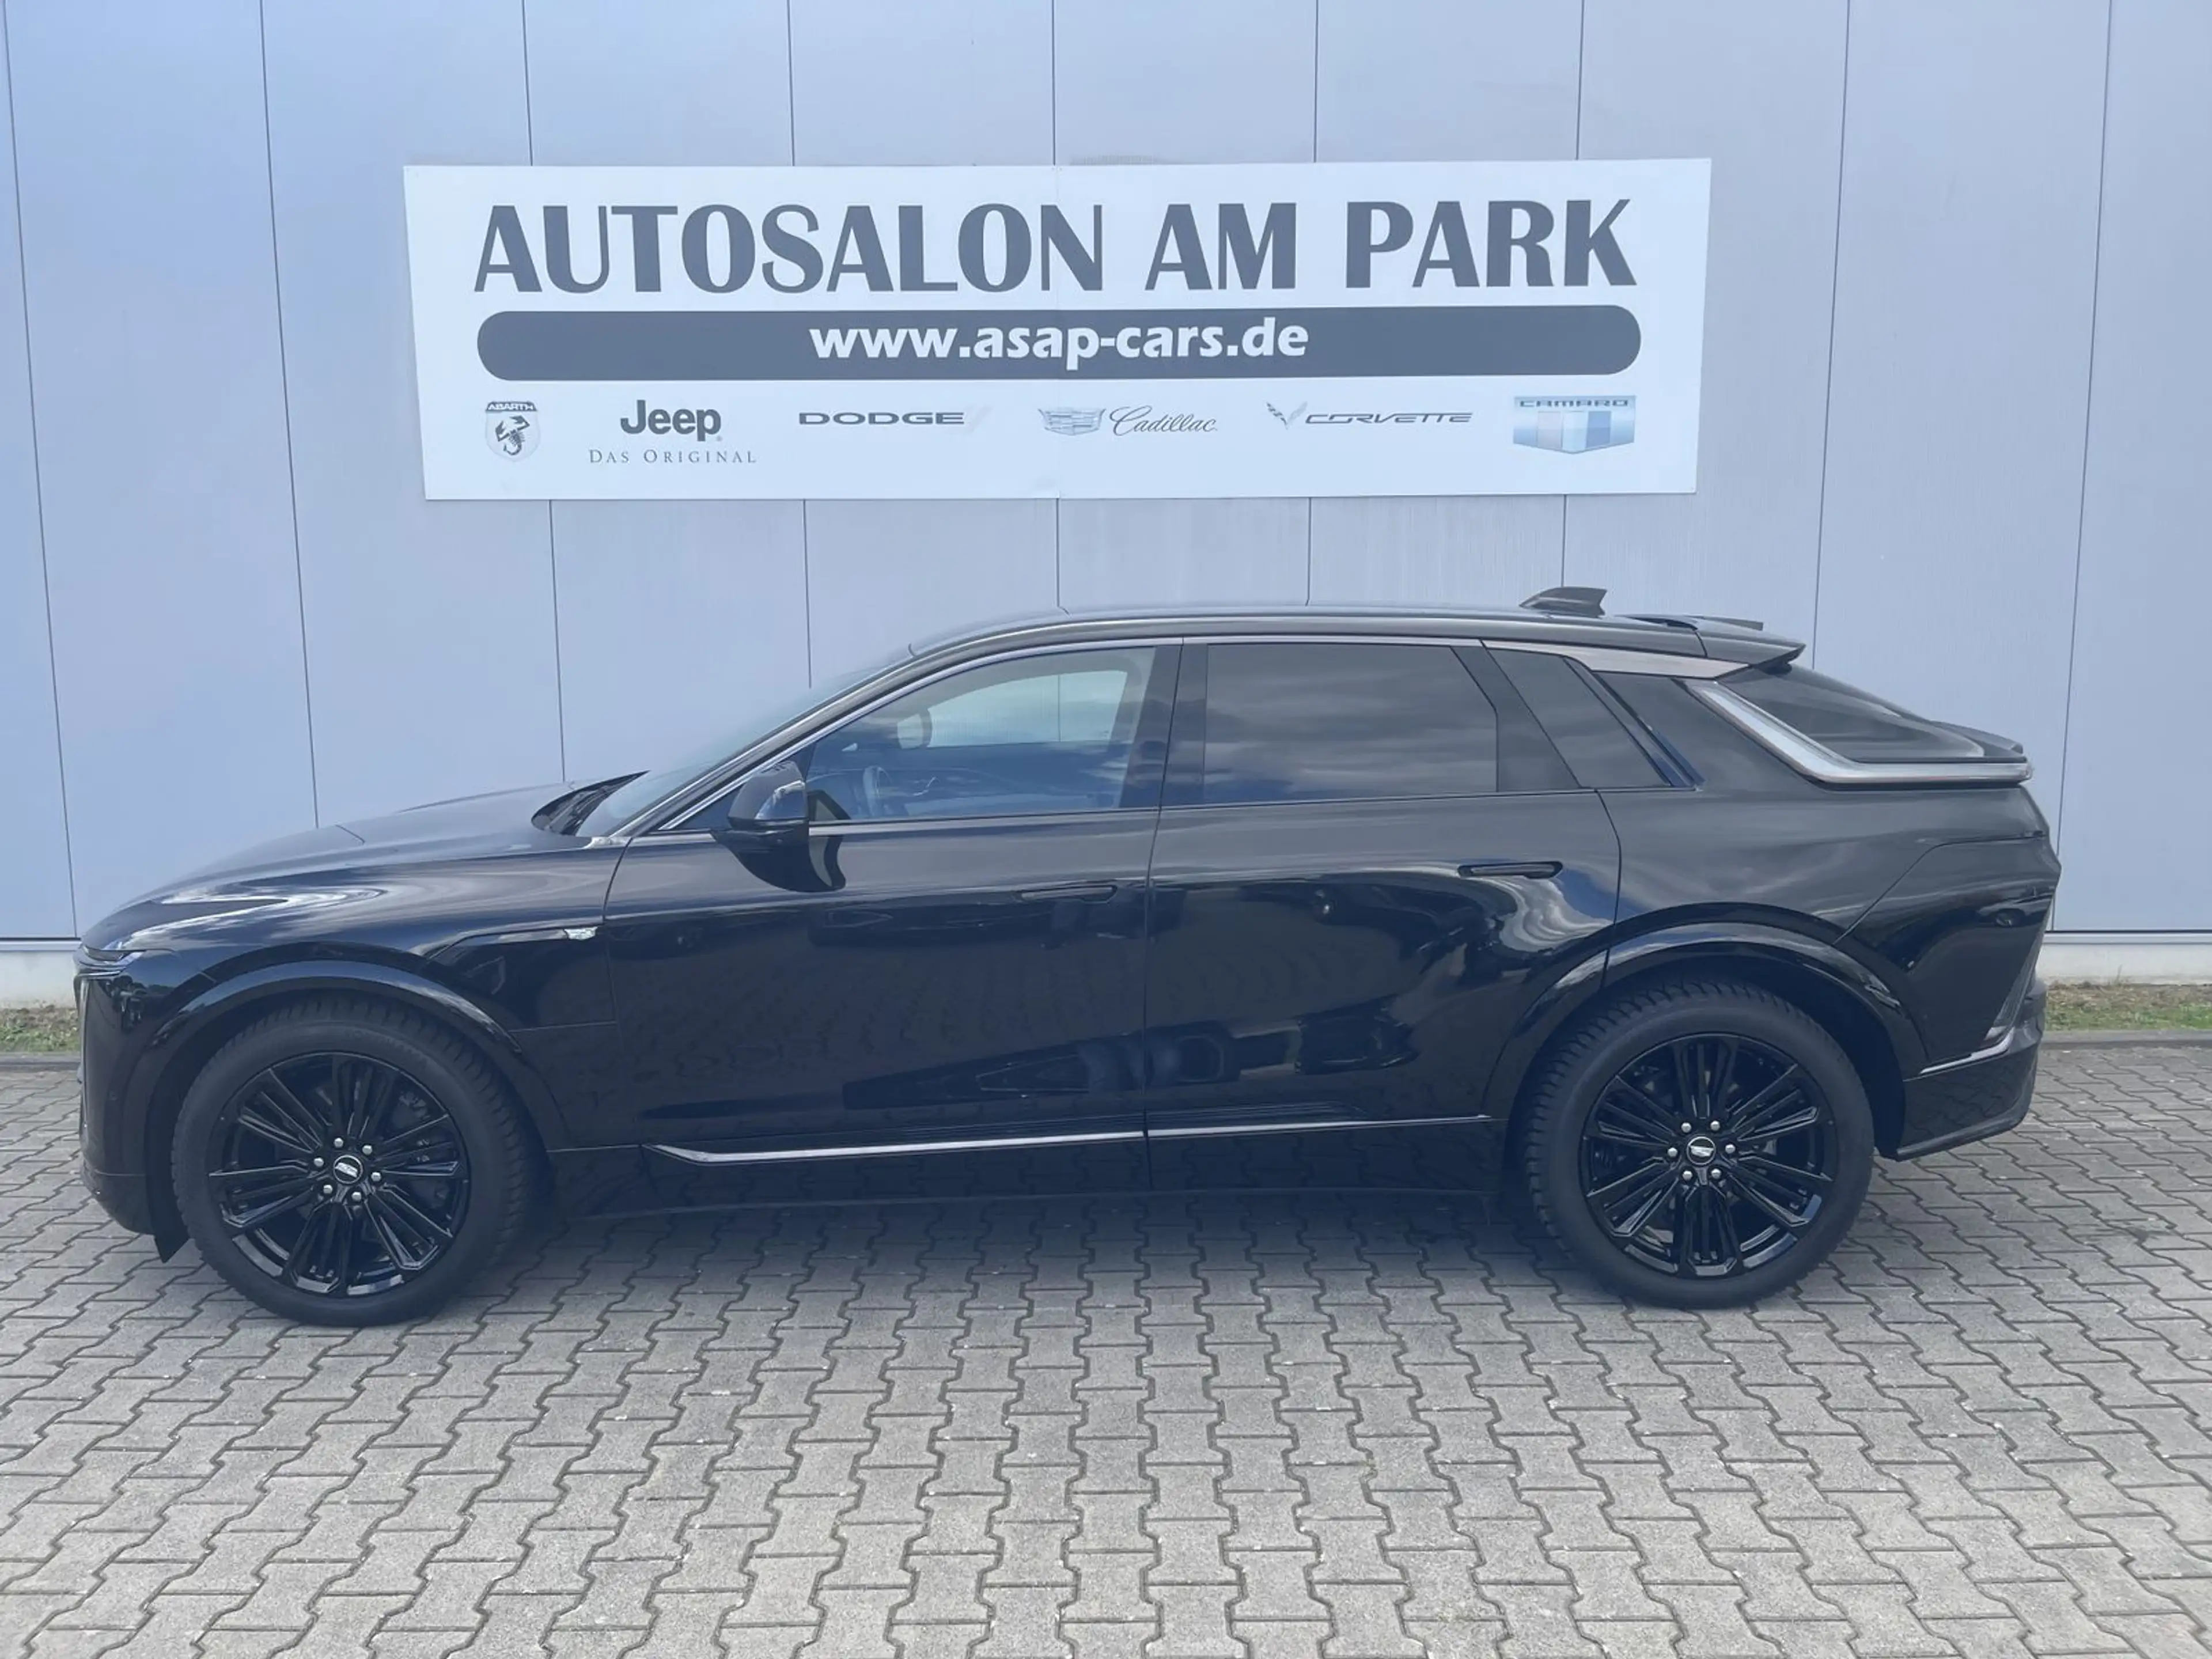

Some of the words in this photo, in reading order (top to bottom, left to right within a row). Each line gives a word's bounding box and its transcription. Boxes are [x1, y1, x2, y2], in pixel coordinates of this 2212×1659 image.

[475, 203, 1103, 294] AUTOSALON
[1145, 202, 1297, 291] AM
[1346, 199, 1637, 289] PARK
[809, 317, 1308, 370] www.asap-cars.de
[487, 403, 534, 411] ABARTH
[1520, 399, 1628, 407] CAMARO
[620, 399, 721, 441] Jeep
[799, 412, 964, 425] DODGE
[1109, 404, 1217, 436] Cadillac
[1305, 412, 1473, 425] CORVETTE
[589, 449, 629, 463] DAS
[643, 449, 756, 463] ORIGINAL
